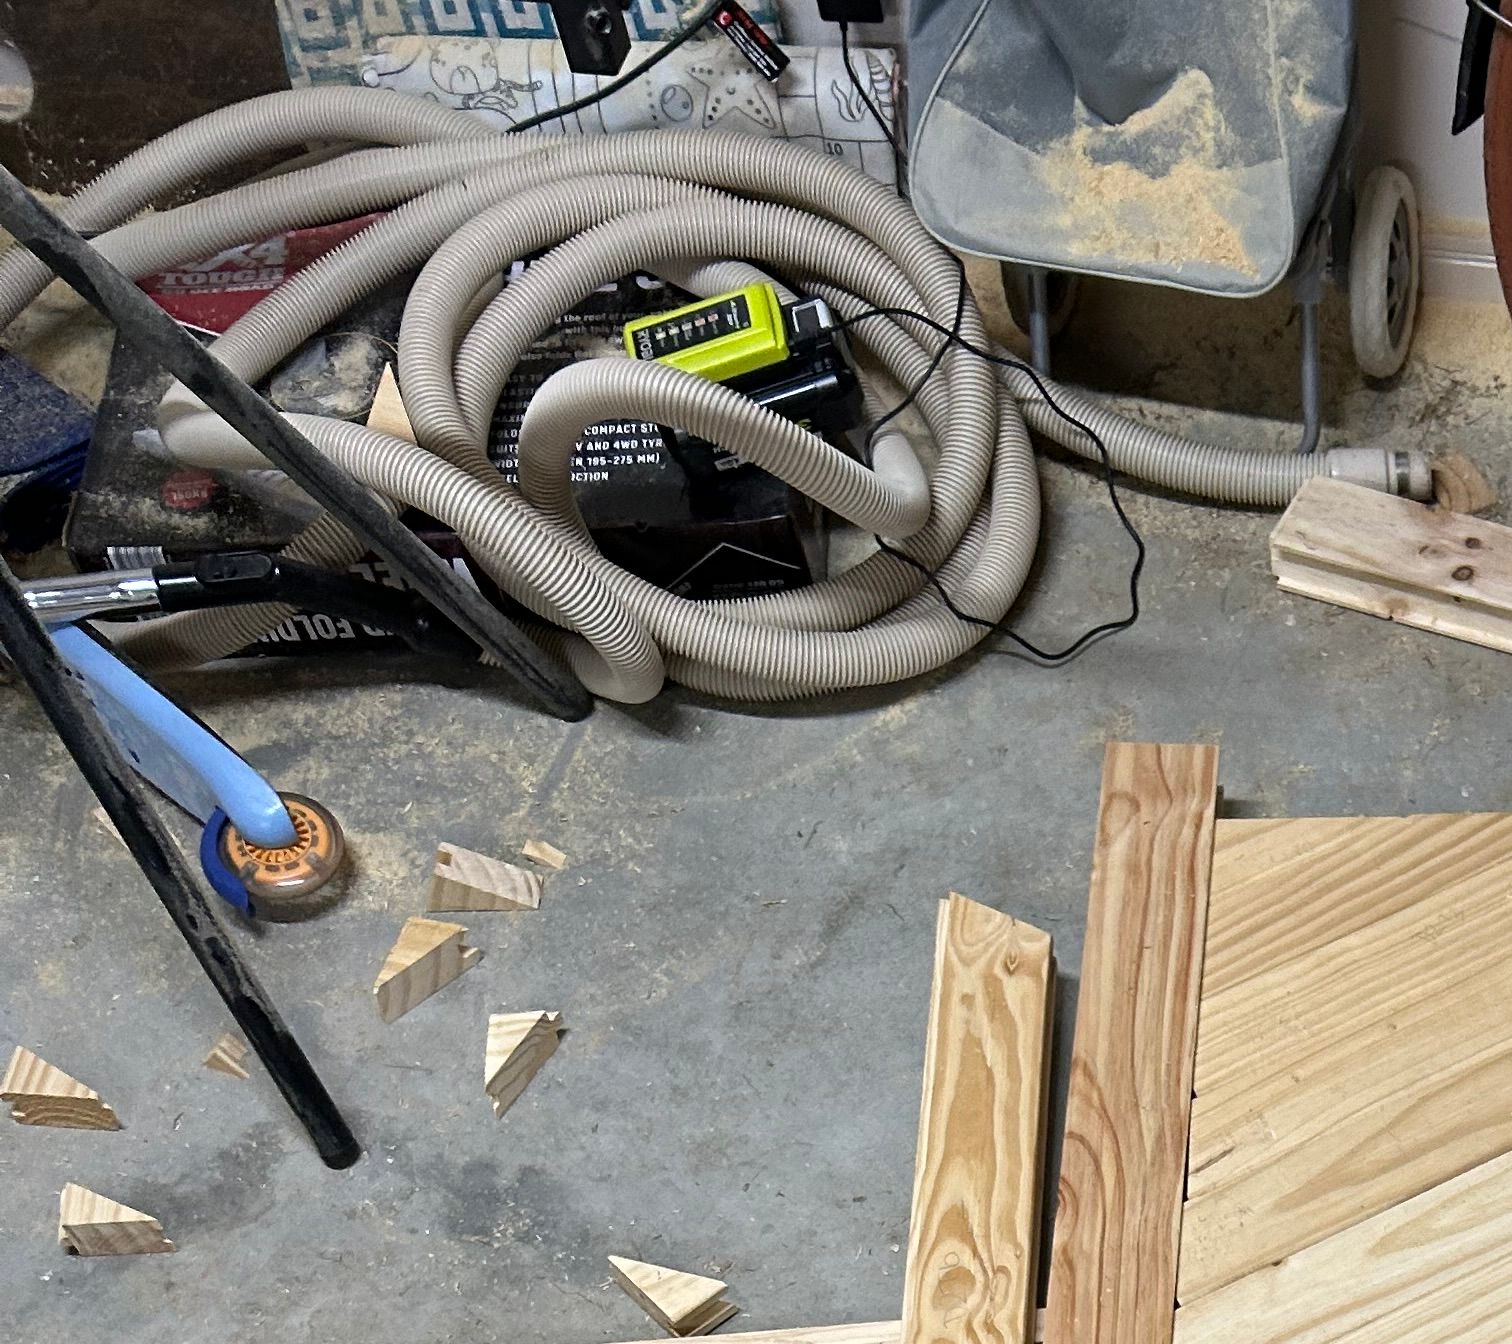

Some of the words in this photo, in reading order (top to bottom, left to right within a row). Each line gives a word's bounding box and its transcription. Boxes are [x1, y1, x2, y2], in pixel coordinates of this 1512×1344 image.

[827, 142, 843, 155] 10
[159, 267, 285, 286] TOUGH
[637, 329, 653, 361] RYOB
[585, 423, 636, 436] COMPACT
[587, 441, 610, 451] AND
[613, 440, 638, 449] 4WD
[642, 438, 662, 448] TYR
[587, 456, 633, 466] 195-275
[637, 452, 660, 464] MM)
[257, 613, 355, 640] FOLDI
